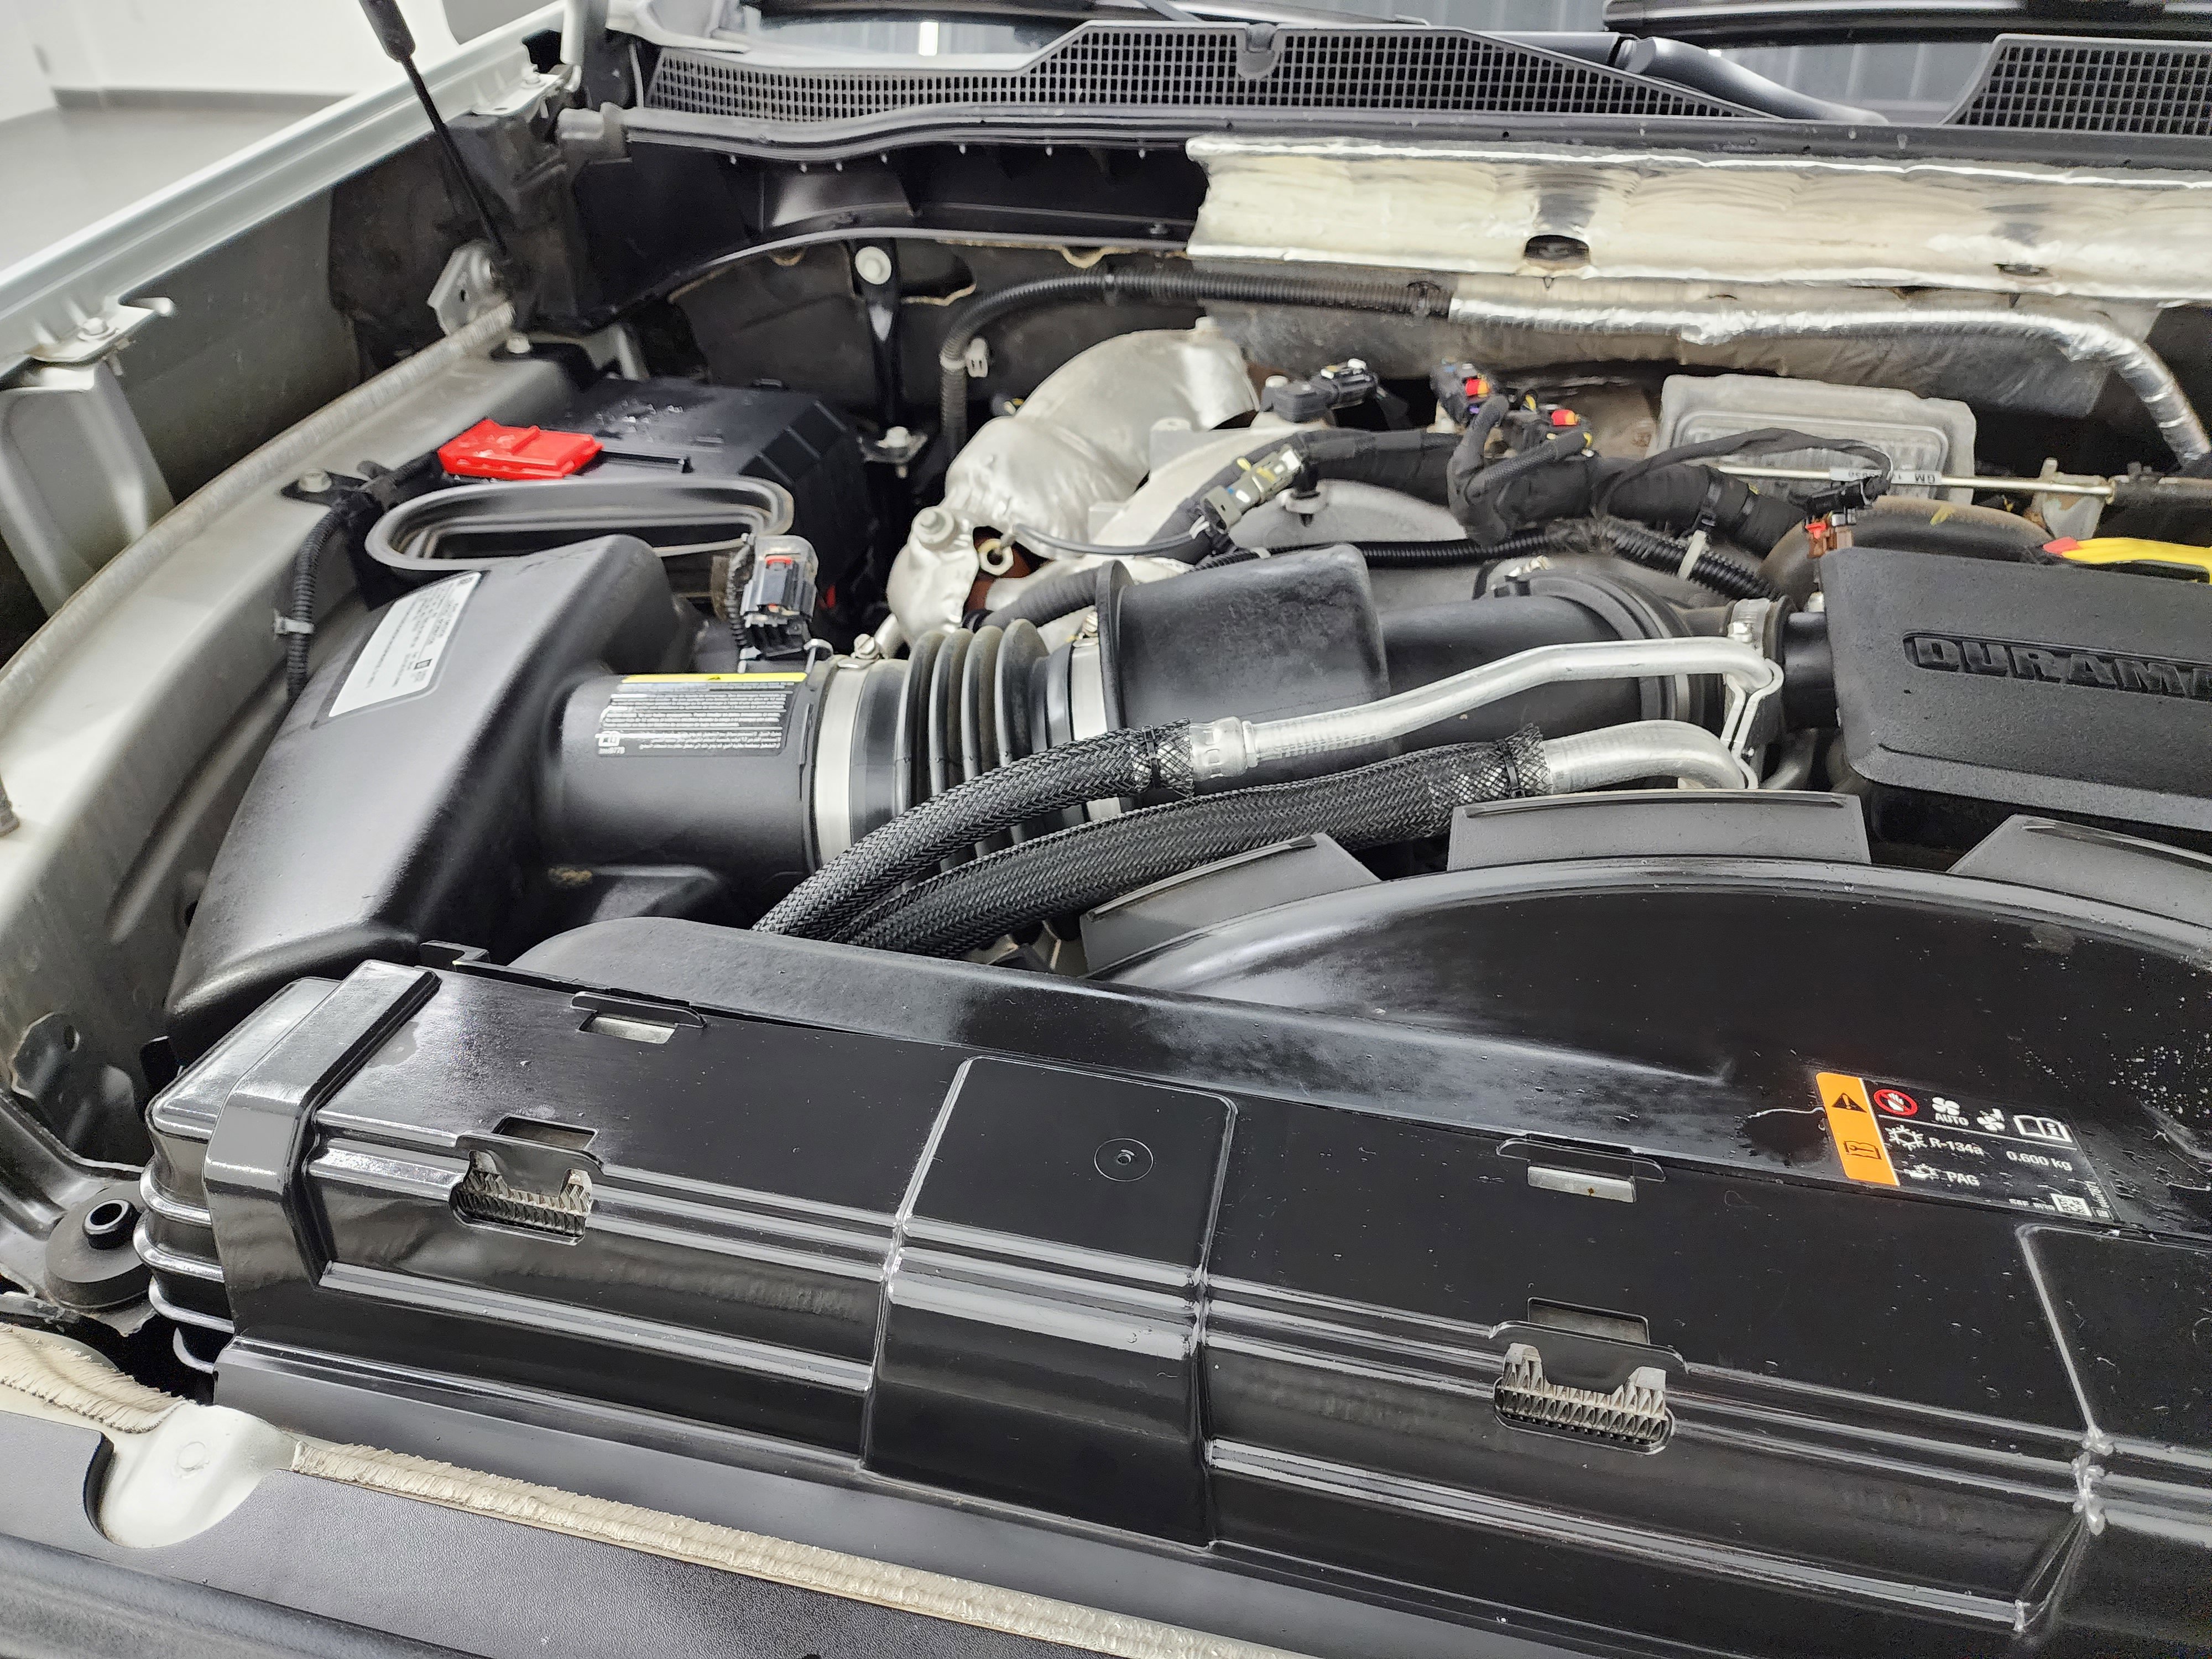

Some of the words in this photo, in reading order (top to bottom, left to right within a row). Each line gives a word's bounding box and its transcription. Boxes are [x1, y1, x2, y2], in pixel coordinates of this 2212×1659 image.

[1935, 1113, 1969, 1126] AUTO
[1928, 1137, 1984, 1156] R-134a
[2006, 1150, 2049, 1166] 0.600
[2051, 1158, 2073, 1172] kg
[1946, 1171, 1980, 1187] PAG
